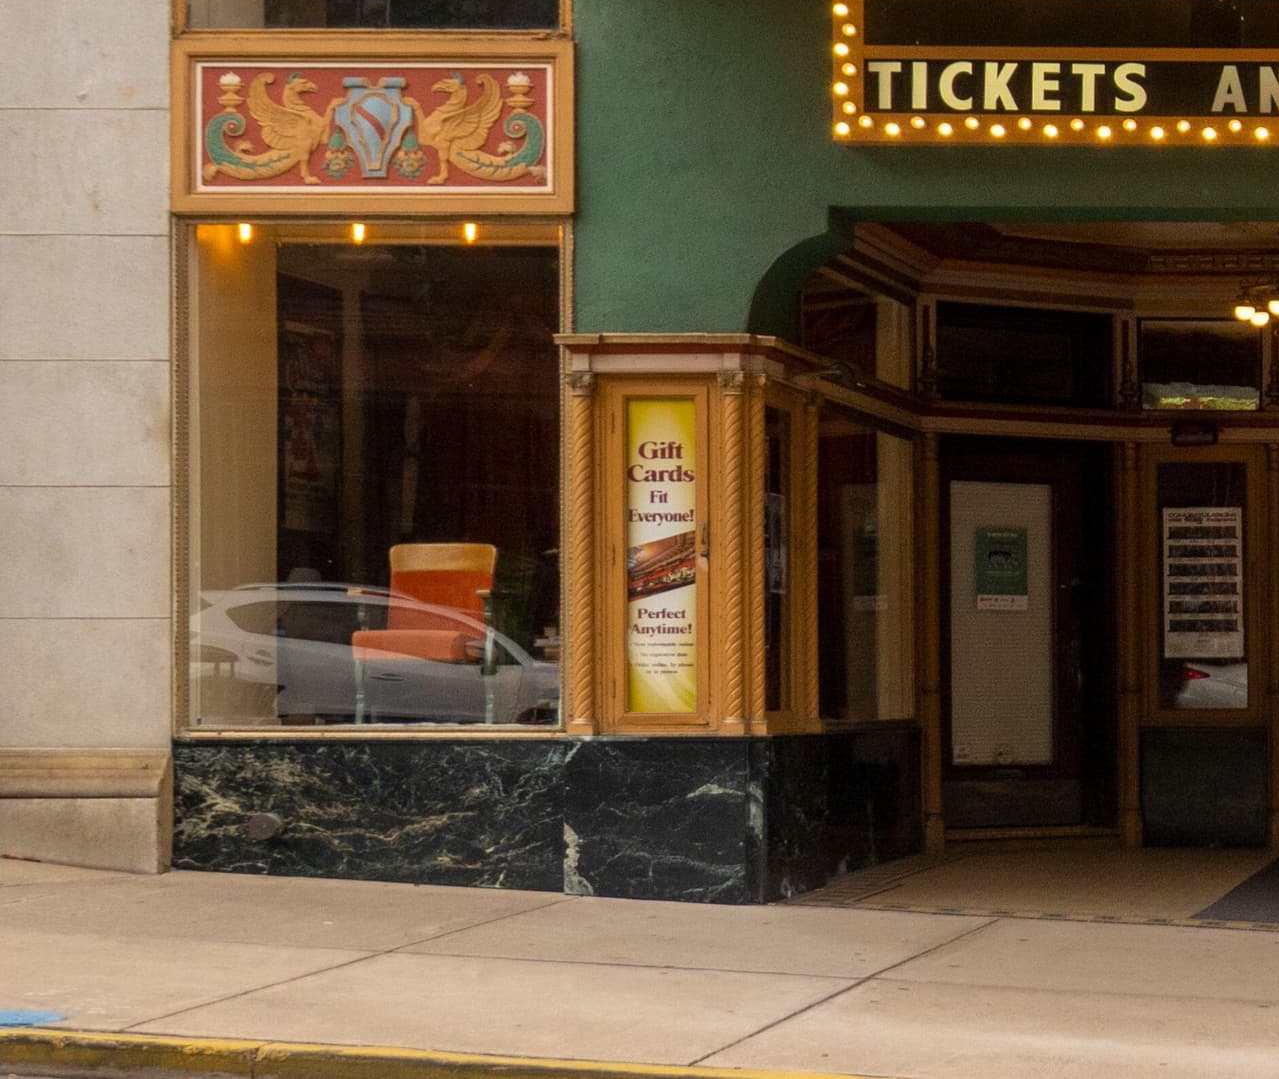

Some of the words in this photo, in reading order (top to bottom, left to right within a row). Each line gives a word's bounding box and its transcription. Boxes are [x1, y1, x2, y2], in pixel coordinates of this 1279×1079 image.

[867, 61, 1149, 113] TICKETS
[638, 441, 683, 459] Gift
[626, 464, 695, 483] Cards
[649, 490, 668, 504] Fit
[628, 509, 695, 526] Everyone!
[637, 608, 686, 619] Perfect
[631, 623, 693, 637] Anytime!
